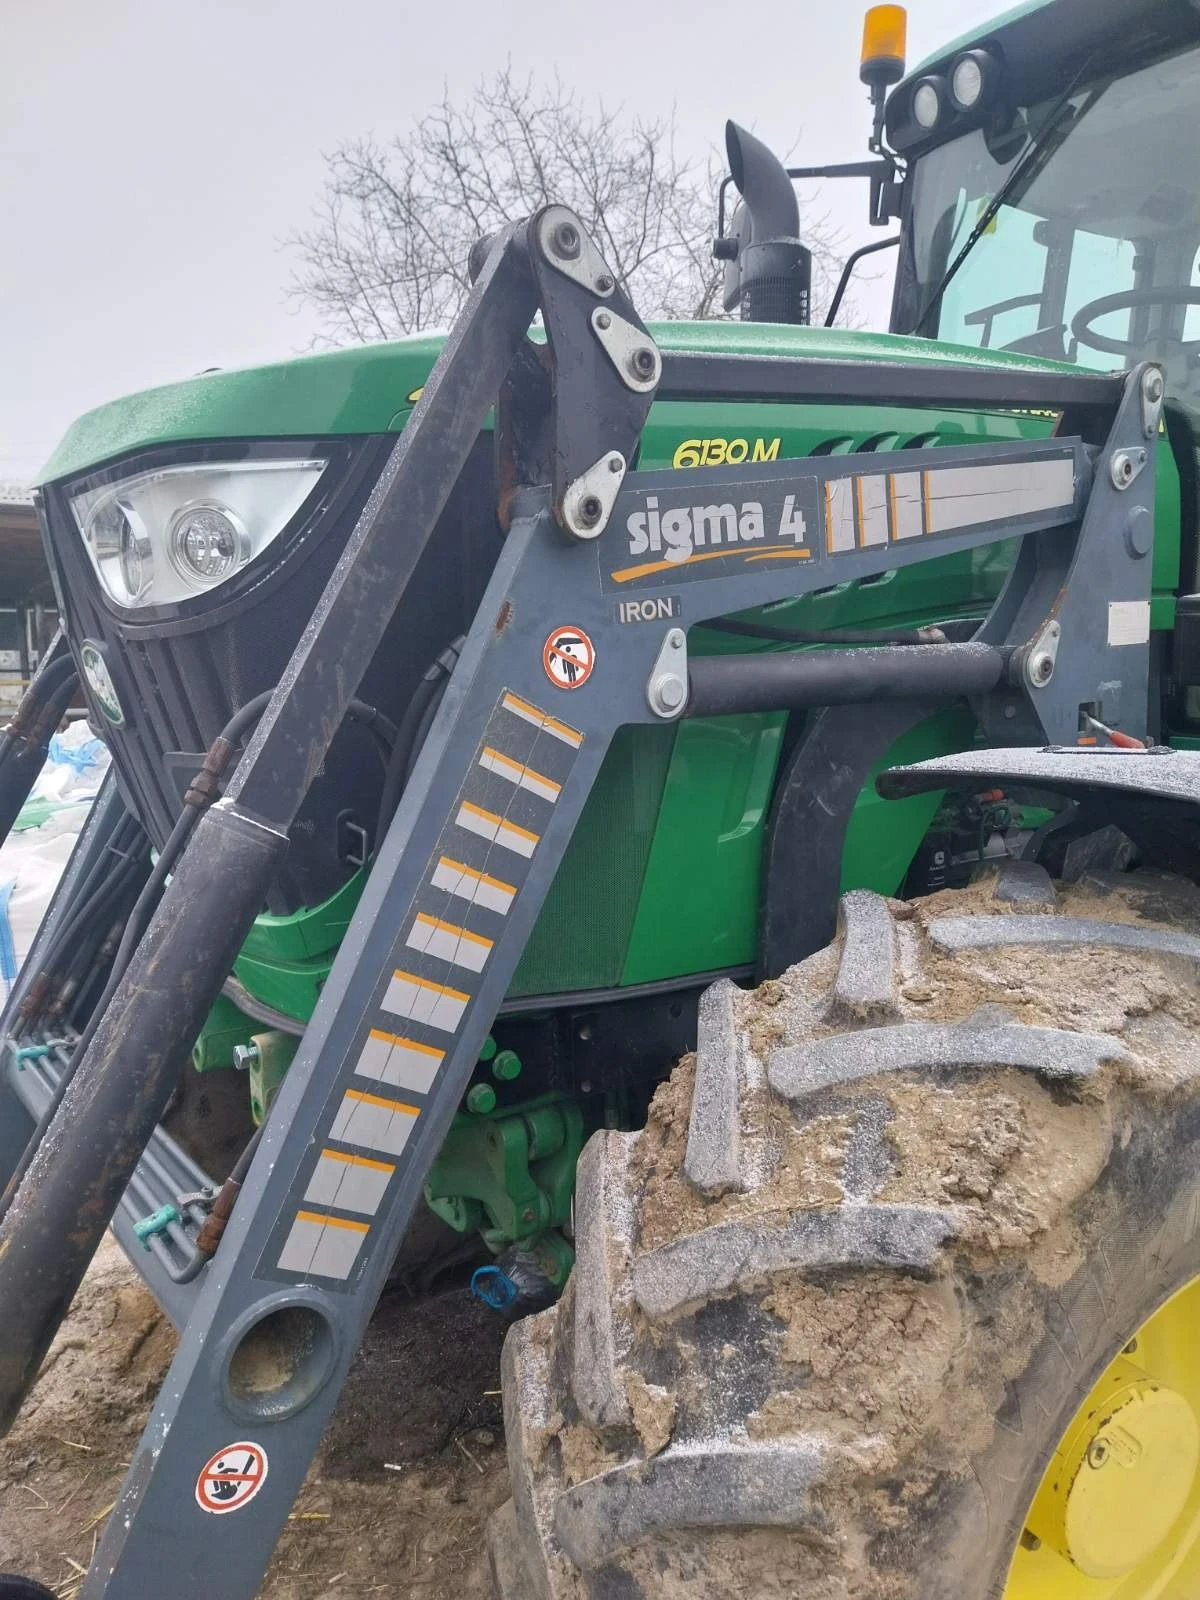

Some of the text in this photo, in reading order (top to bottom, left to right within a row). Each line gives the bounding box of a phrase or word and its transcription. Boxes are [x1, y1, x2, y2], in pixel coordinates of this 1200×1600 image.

[626, 494, 807, 563] sigma 4
[619, 597, 673, 624] IRON
